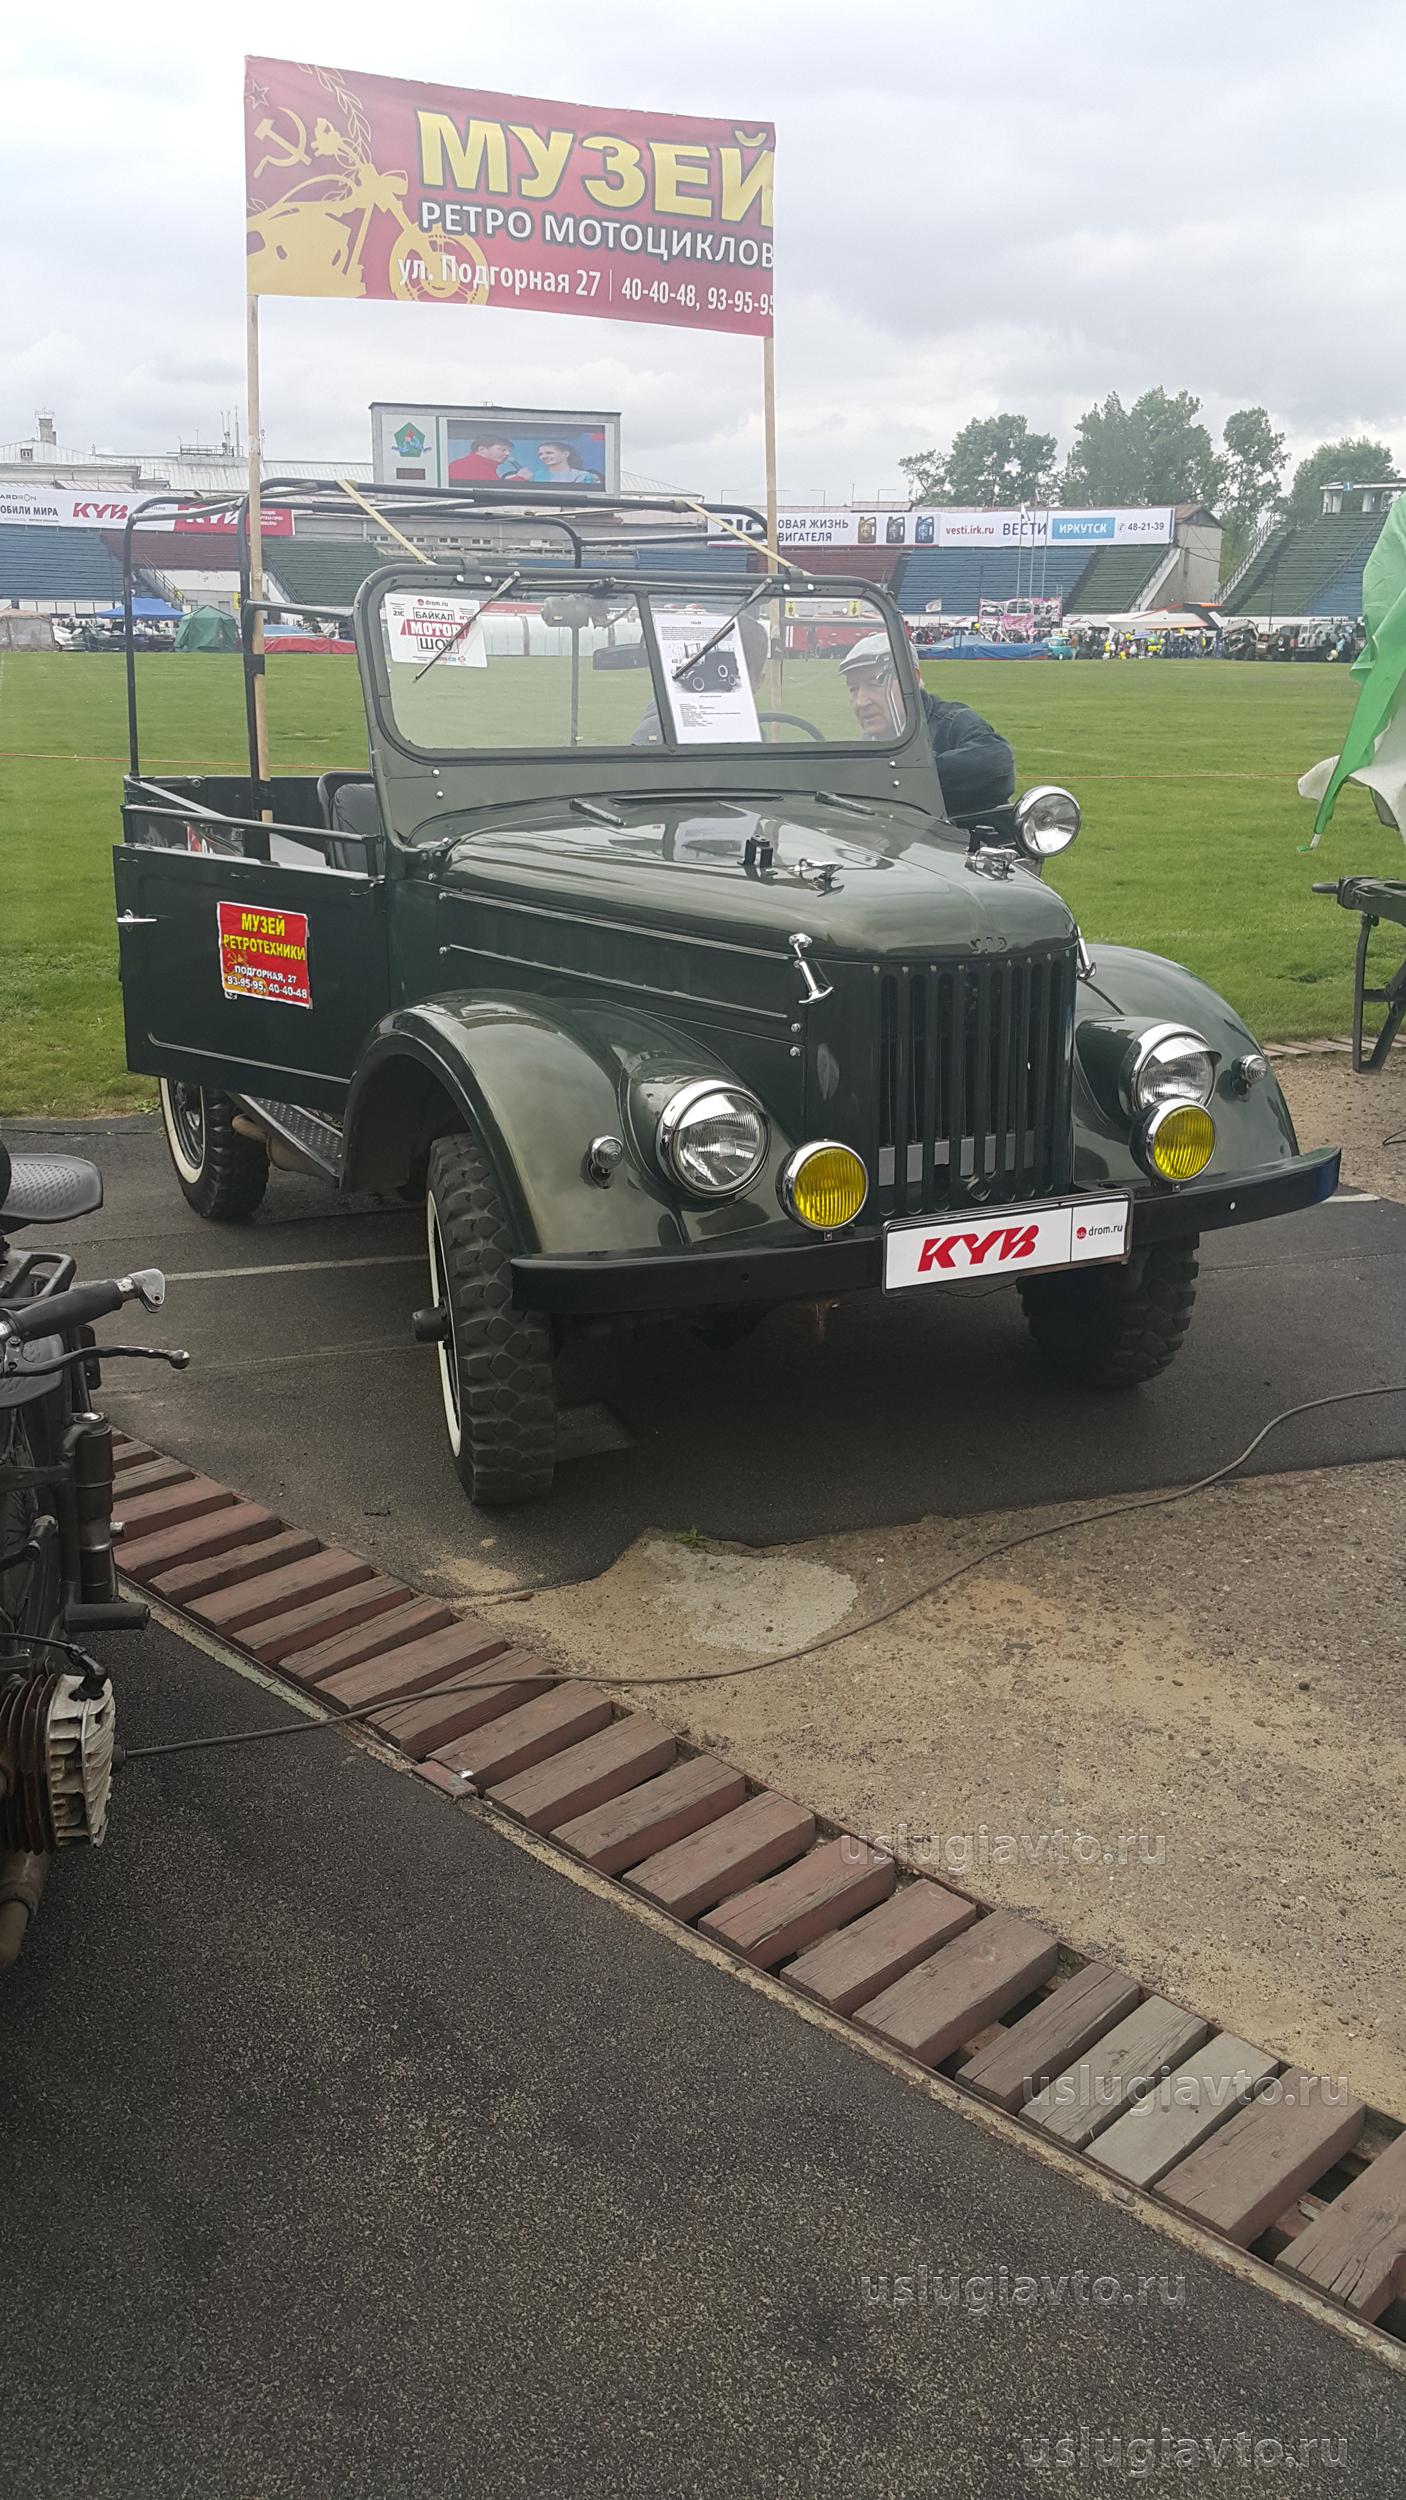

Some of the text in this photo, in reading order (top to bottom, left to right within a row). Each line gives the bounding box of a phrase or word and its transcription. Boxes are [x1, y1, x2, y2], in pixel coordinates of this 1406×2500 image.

[416, 110, 774, 228] МУЗЕЙ
[421, 201, 774, 268] РЕТРО МОТОЦИКЛОВ
[398, 255, 774, 317] ул. Подгорная 27 40-40-48, 93-95-95
[1, 504, 59, 516] ОБИЛИ МИРА
[73, 502, 129, 520] KYB
[778, 518, 849, 530] ОВАЯ ЖИЗНЬ
[946, 523, 995, 535] vesti.irk.ru
[1002, 521, 1108, 536] ВЕСТИ ИРКУТСК
[1127, 522, 1165, 532] 48-21-39
[778, 532, 832, 543] ВИГАТЕЛЯ
[415, 611, 454, 621] БАЙКАЛ
[409, 621, 462, 637] МОТОР
[420, 638, 454, 651] ШОУ
[241, 913, 285, 937] МУЗЕЙ
[223, 934, 306, 960] РЕТРОТЕХНИКИ
[234, 965, 297, 983] ПОДГОРНАЯ, 27
[227, 975, 308, 998] 93-95-95, 40-40-48
[917, 1224, 1123, 1272] KYB drom.ru
